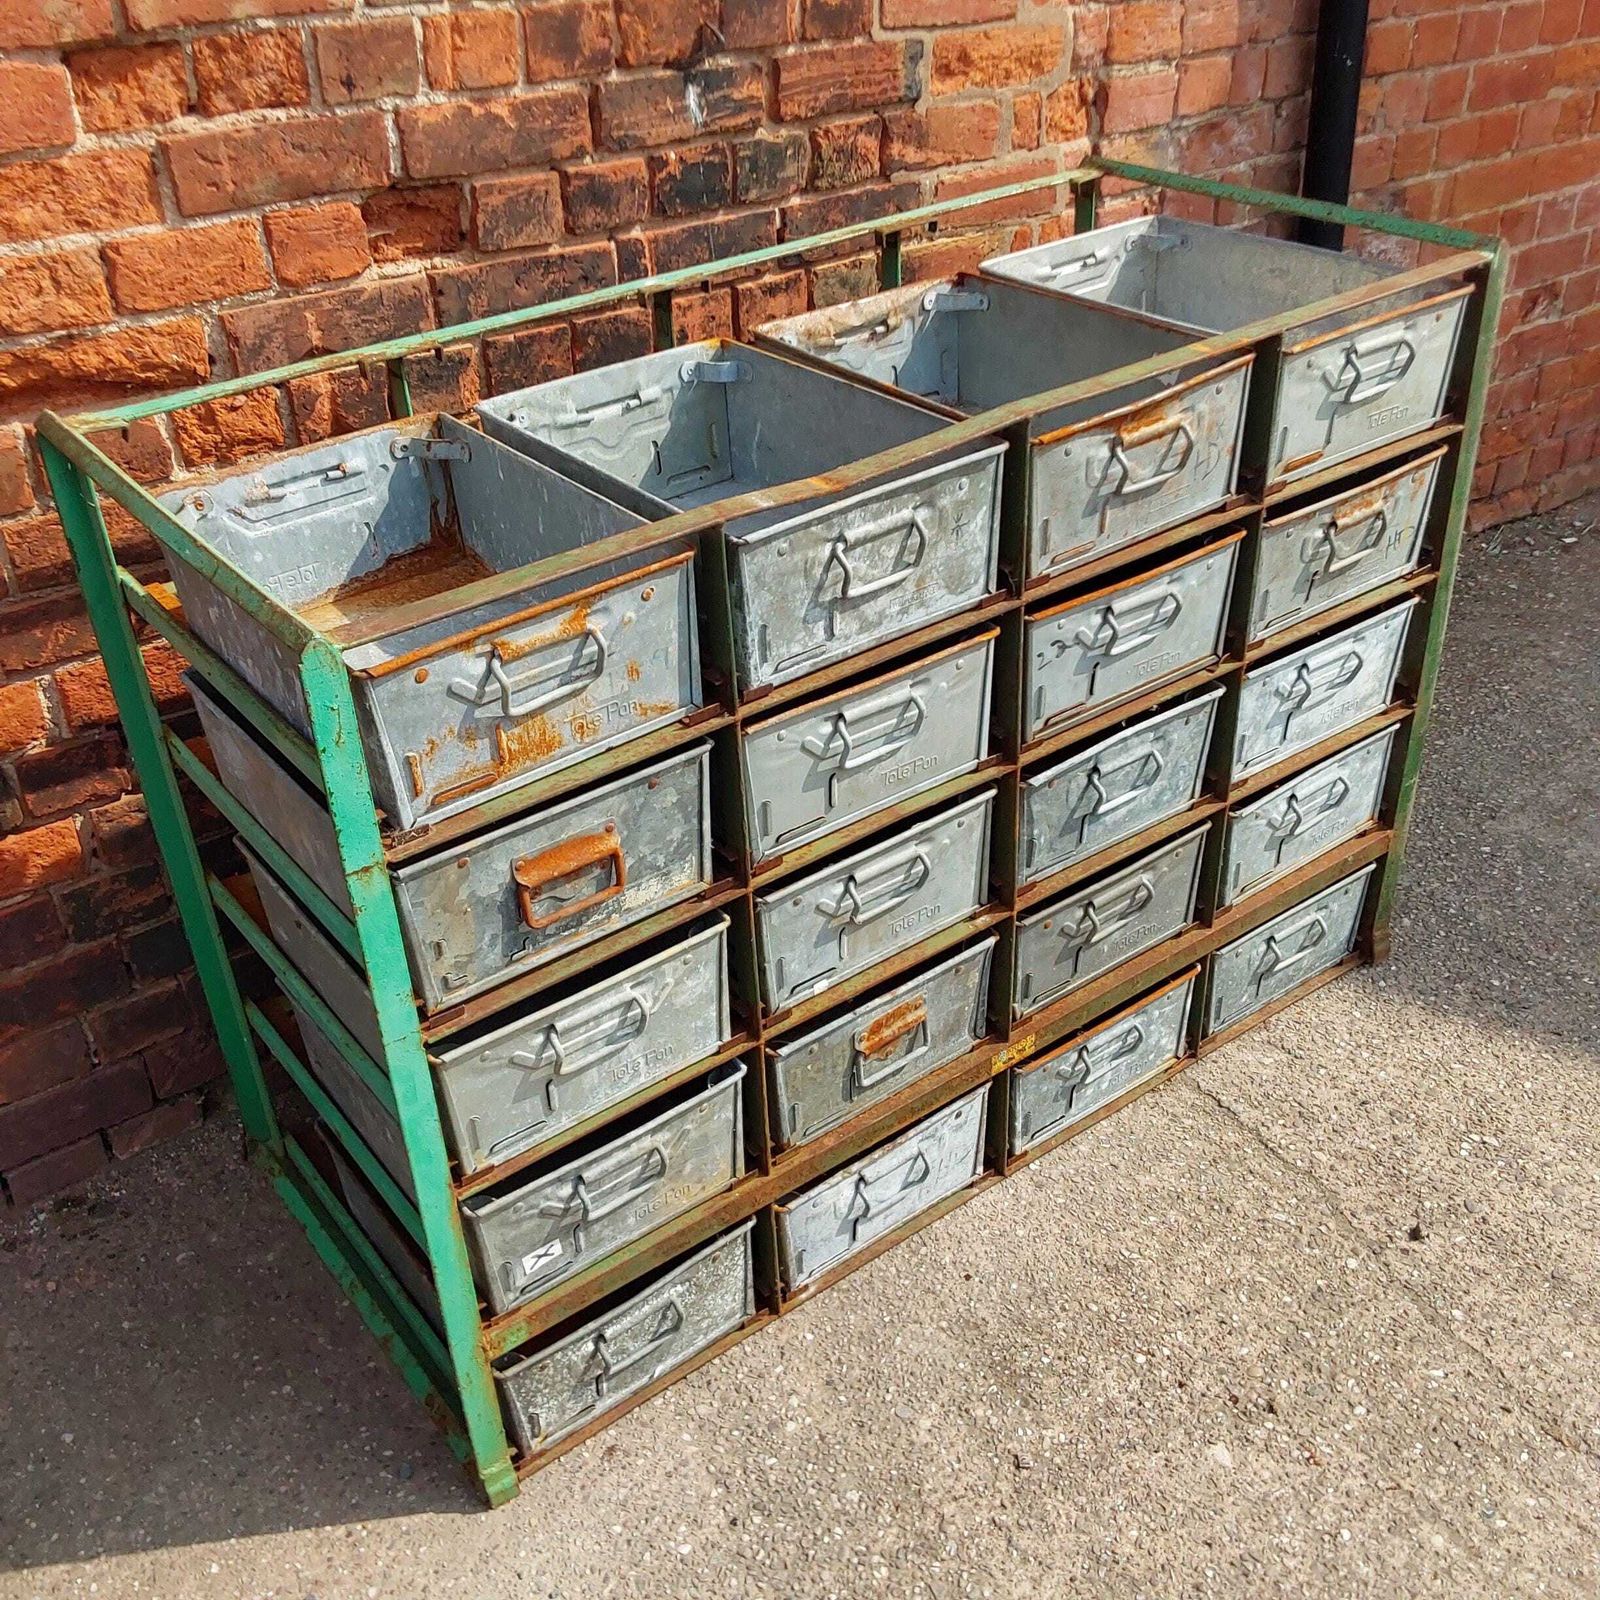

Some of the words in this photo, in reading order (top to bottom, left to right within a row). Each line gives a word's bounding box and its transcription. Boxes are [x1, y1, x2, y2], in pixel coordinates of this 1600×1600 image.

[605, 699, 638, 721] Pan
[912, 754, 938, 774] Pan
[917, 904, 941, 923] Pan
[644, 1046, 674, 1066] Pan
